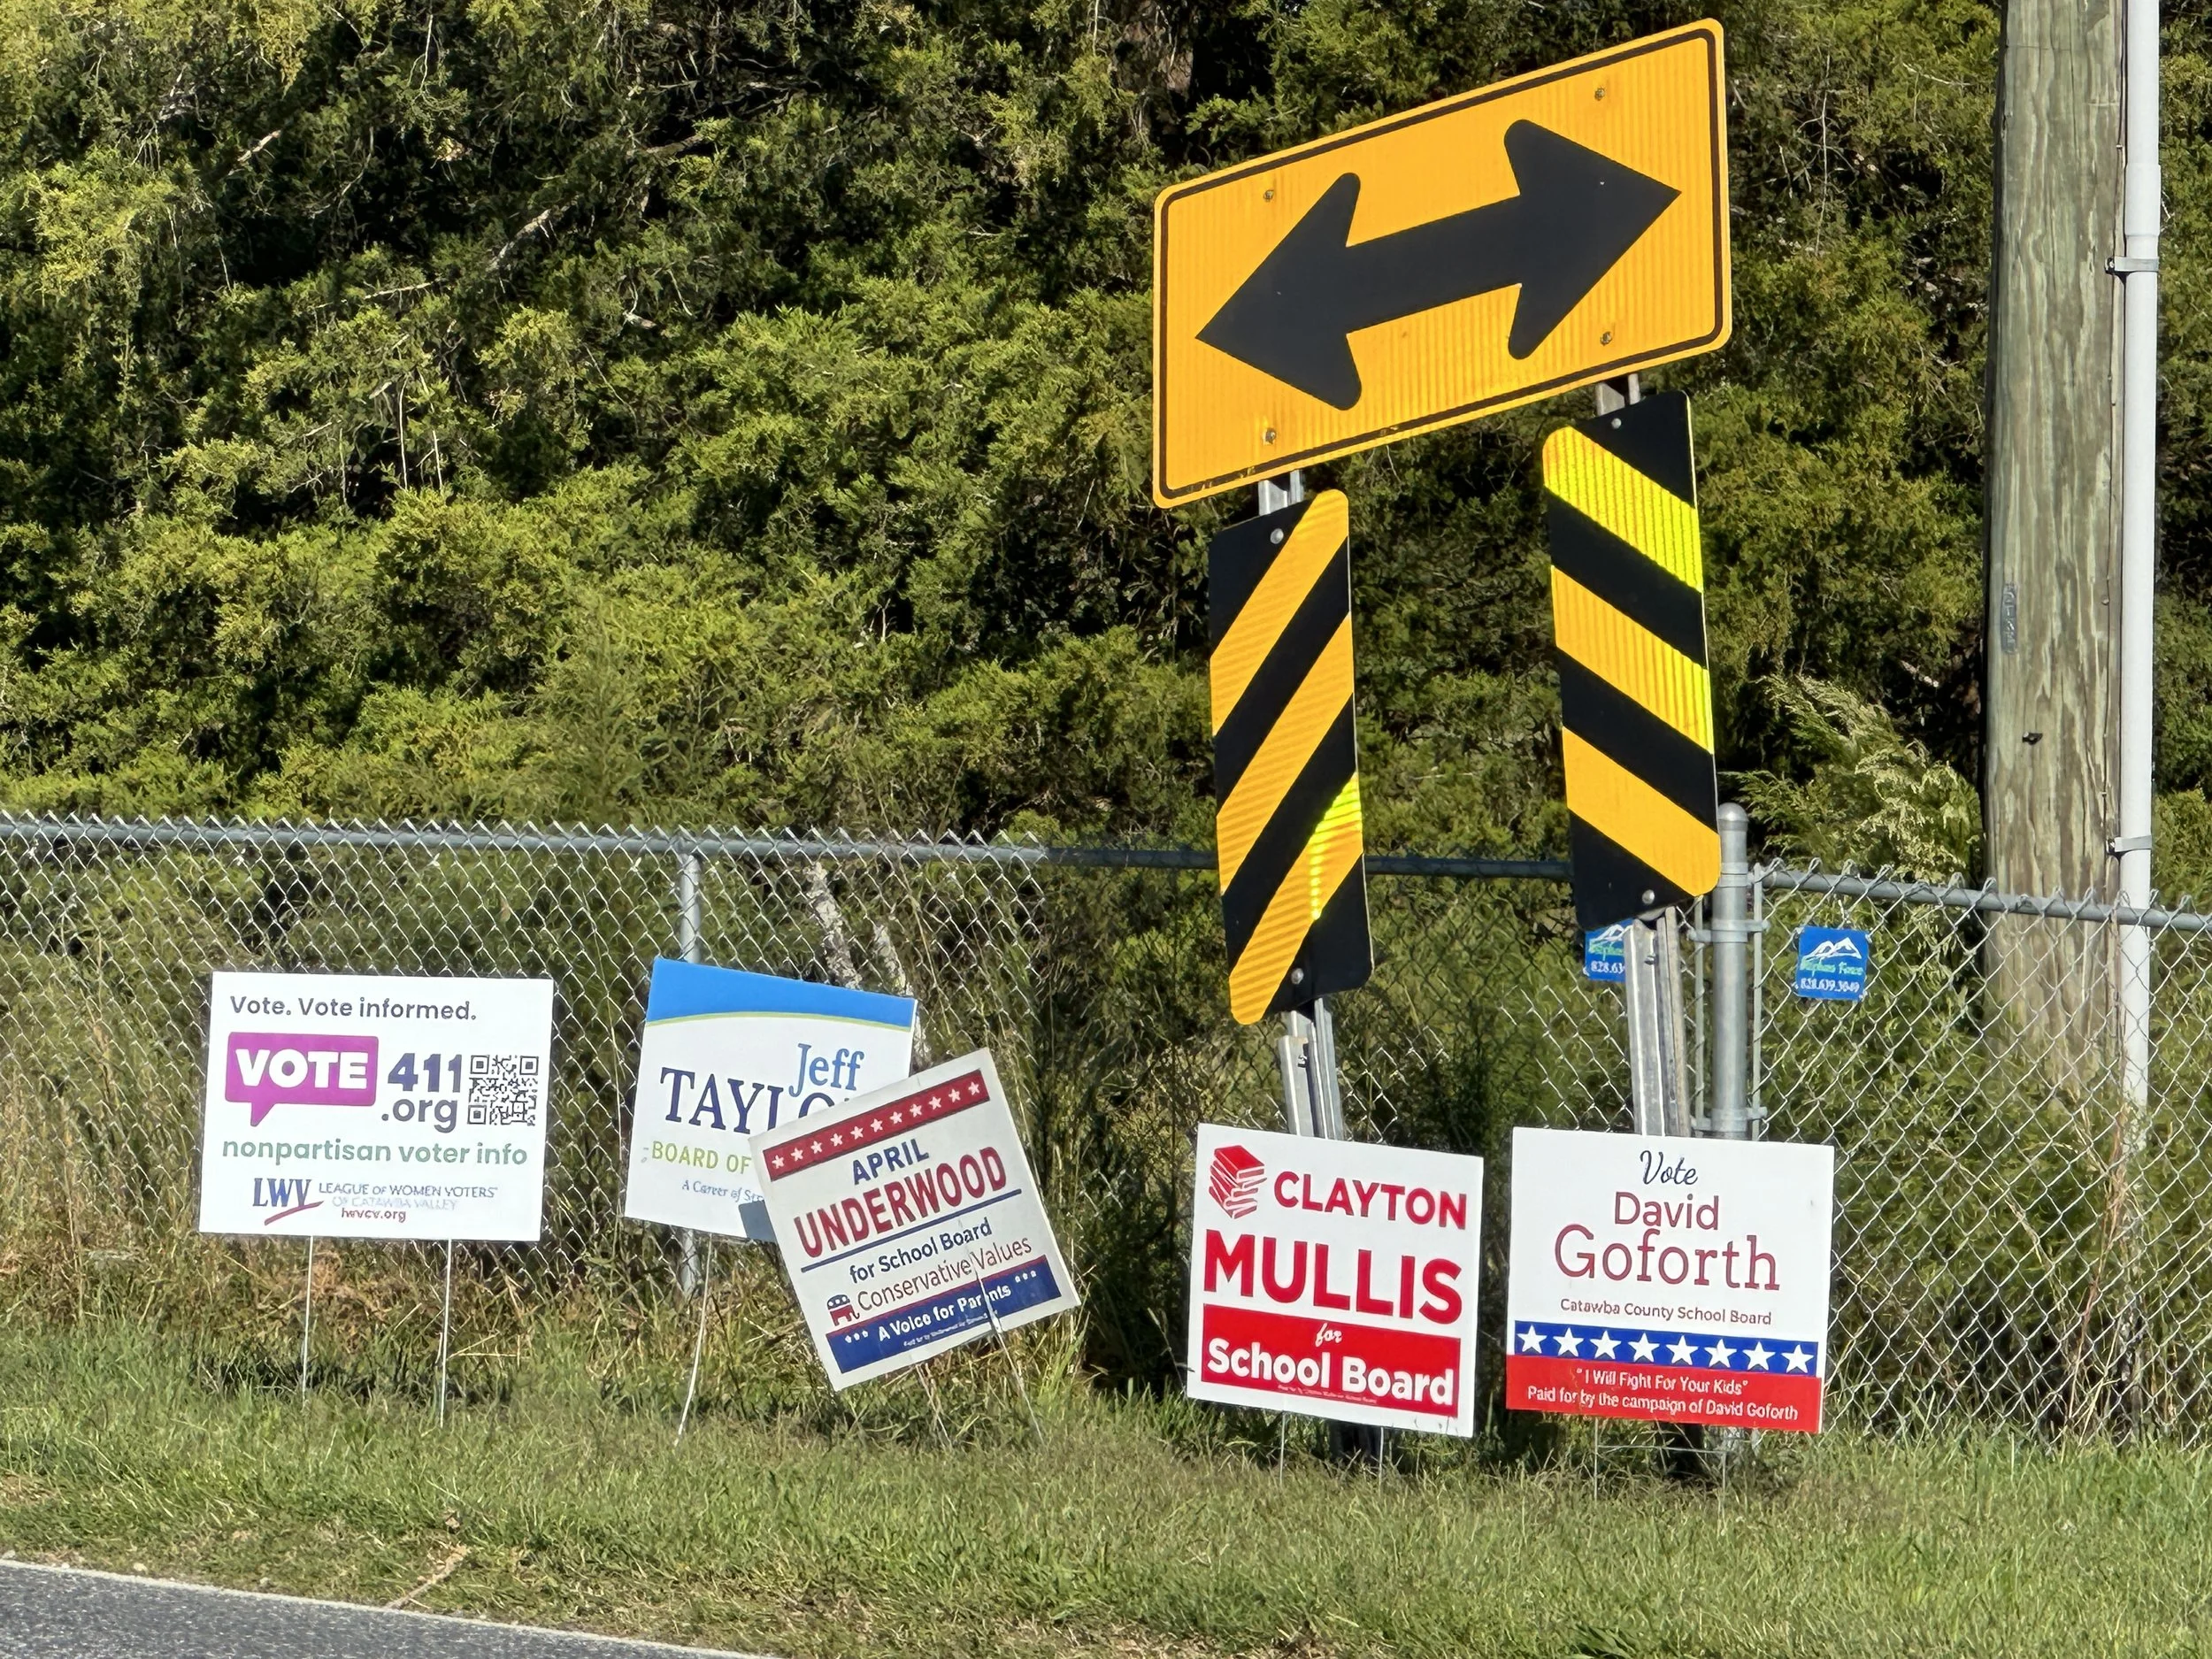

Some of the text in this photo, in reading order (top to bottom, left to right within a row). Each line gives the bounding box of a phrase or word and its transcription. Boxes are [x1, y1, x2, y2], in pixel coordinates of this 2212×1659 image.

[230, 995, 477, 1020] Vote. Vote informed.
[234, 1048, 463, 1094] VOTE 411
[788, 1042, 865, 1097] Jeff
[381, 1098, 458, 1133] .org
[223, 1138, 527, 1166] nonpartisan voter info
[651, 1141, 752, 1175] BOARD OF
[852, 1138, 930, 1186] APRIL
[1640, 1149, 1699, 1185] Vote
[252, 1178, 311, 1208] LWV
[319, 1182, 370, 1195] LEAGUE
[373, 1185, 387, 1195] OF
[389, 1185, 442, 1196] WOMEN
[681, 1179, 690, 1191] A
[693, 1180, 728, 1197] Career
[730, 1187, 742, 1202] of
[793, 1146, 1007, 1258] UNDERWOOD
[1273, 1171, 1467, 1231] CLAYTON
[1614, 1191, 1719, 1231] David
[849, 1217, 993, 1284] for School Board
[1555, 1224, 1780, 1291] Goforth
[857, 1237, 1033, 1311] Conservative Values
[1203, 1229, 1463, 1325] MULLIS
[878, 1326, 891, 1342] A
[888, 1312, 932, 1336] Voice
[933, 1302, 956, 1322] for
[956, 1284, 1012, 1313] Parnts
[1560, 1298, 1771, 1325] Catawba County School Board
[1315, 1323, 1342, 1347] for
[1207, 1338, 1455, 1406] School Board
[1593, 1369, 1617, 1386] Will
[1619, 1371, 1652, 1391] Fight
[1655, 1374, 1677, 1391] For
[1679, 1376, 1710, 1394] Your
[1527, 1385, 1799, 1421] Paid for by the campaign of David Goforth
